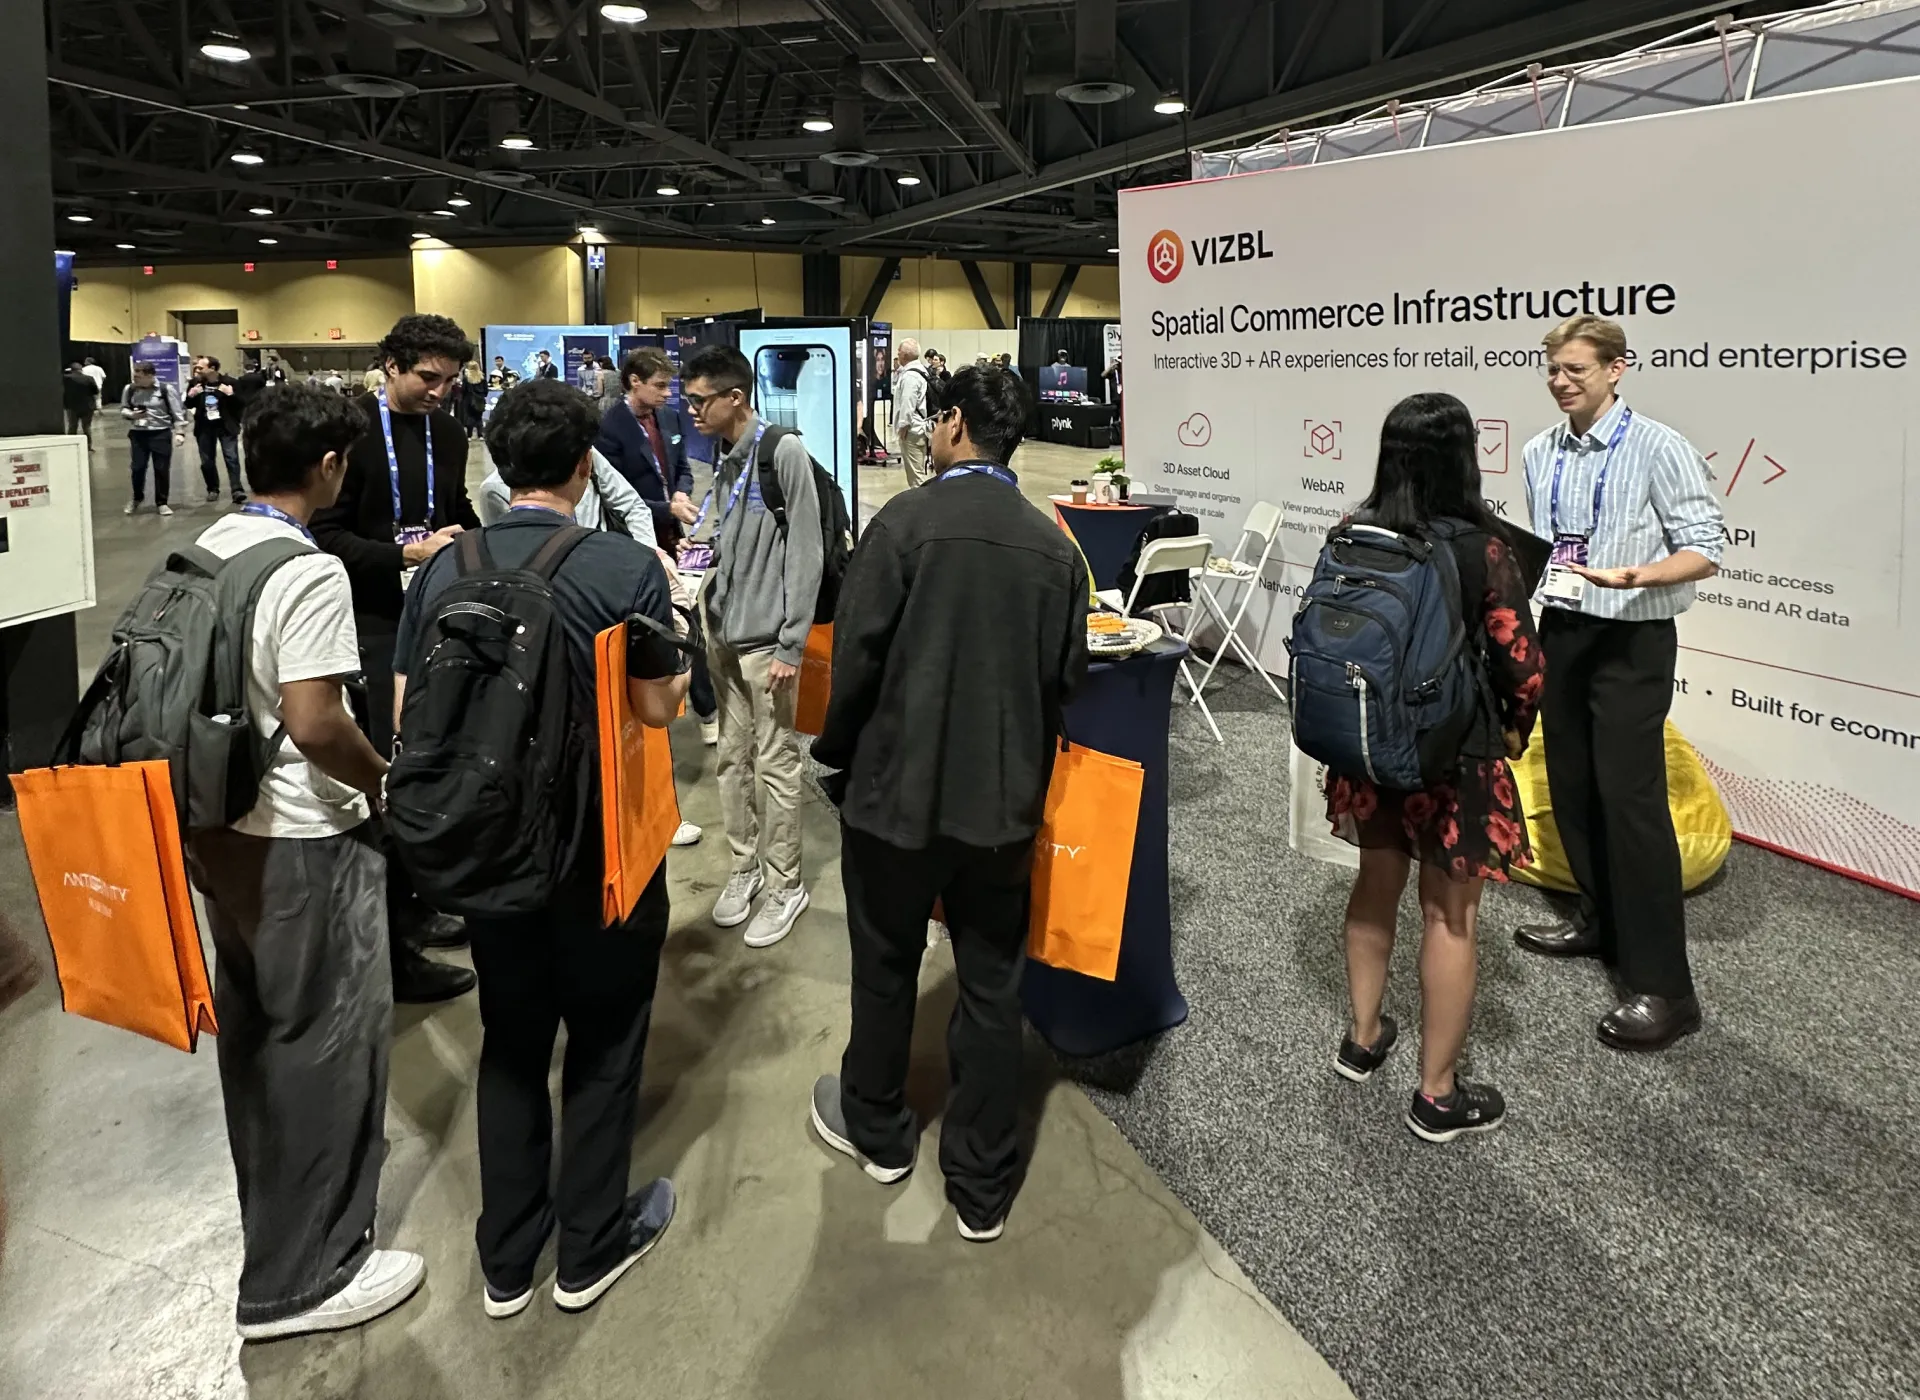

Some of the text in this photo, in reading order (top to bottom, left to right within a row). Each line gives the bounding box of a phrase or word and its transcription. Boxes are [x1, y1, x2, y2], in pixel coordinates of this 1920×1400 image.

[1191, 230, 1273, 266] VIZBL
[1151, 281, 1675, 341] Spatial Commerce Infrastructure
[1154, 340, 1907, 374] Interactive 3D + AR experiences for retail, ecome, and enterprise
[1051, 417, 1072, 430] plynk
[1163, 462, 1230, 480] 3D Asset Cloud
[1301, 477, 1345, 494] WebAR
[1172, 488, 1197, 499] manage
[1198, 491, 1210, 500] and
[1212, 493, 1241, 504] organize
[1179, 505, 1225, 518] assets at scale
[1282, 501, 1302, 512] View
[1303, 504, 1341, 518] products
[1485, 499, 1507, 516] DK
[1309, 524, 1316, 533] in
[1720, 527, 1756, 548] API
[1258, 577, 1306, 598] Native iO
[1768, 575, 1834, 594] access
[1695, 591, 1850, 627] sets and AR data
[1731, 688, 1784, 718] Built
[1790, 703, 1825, 726] for
